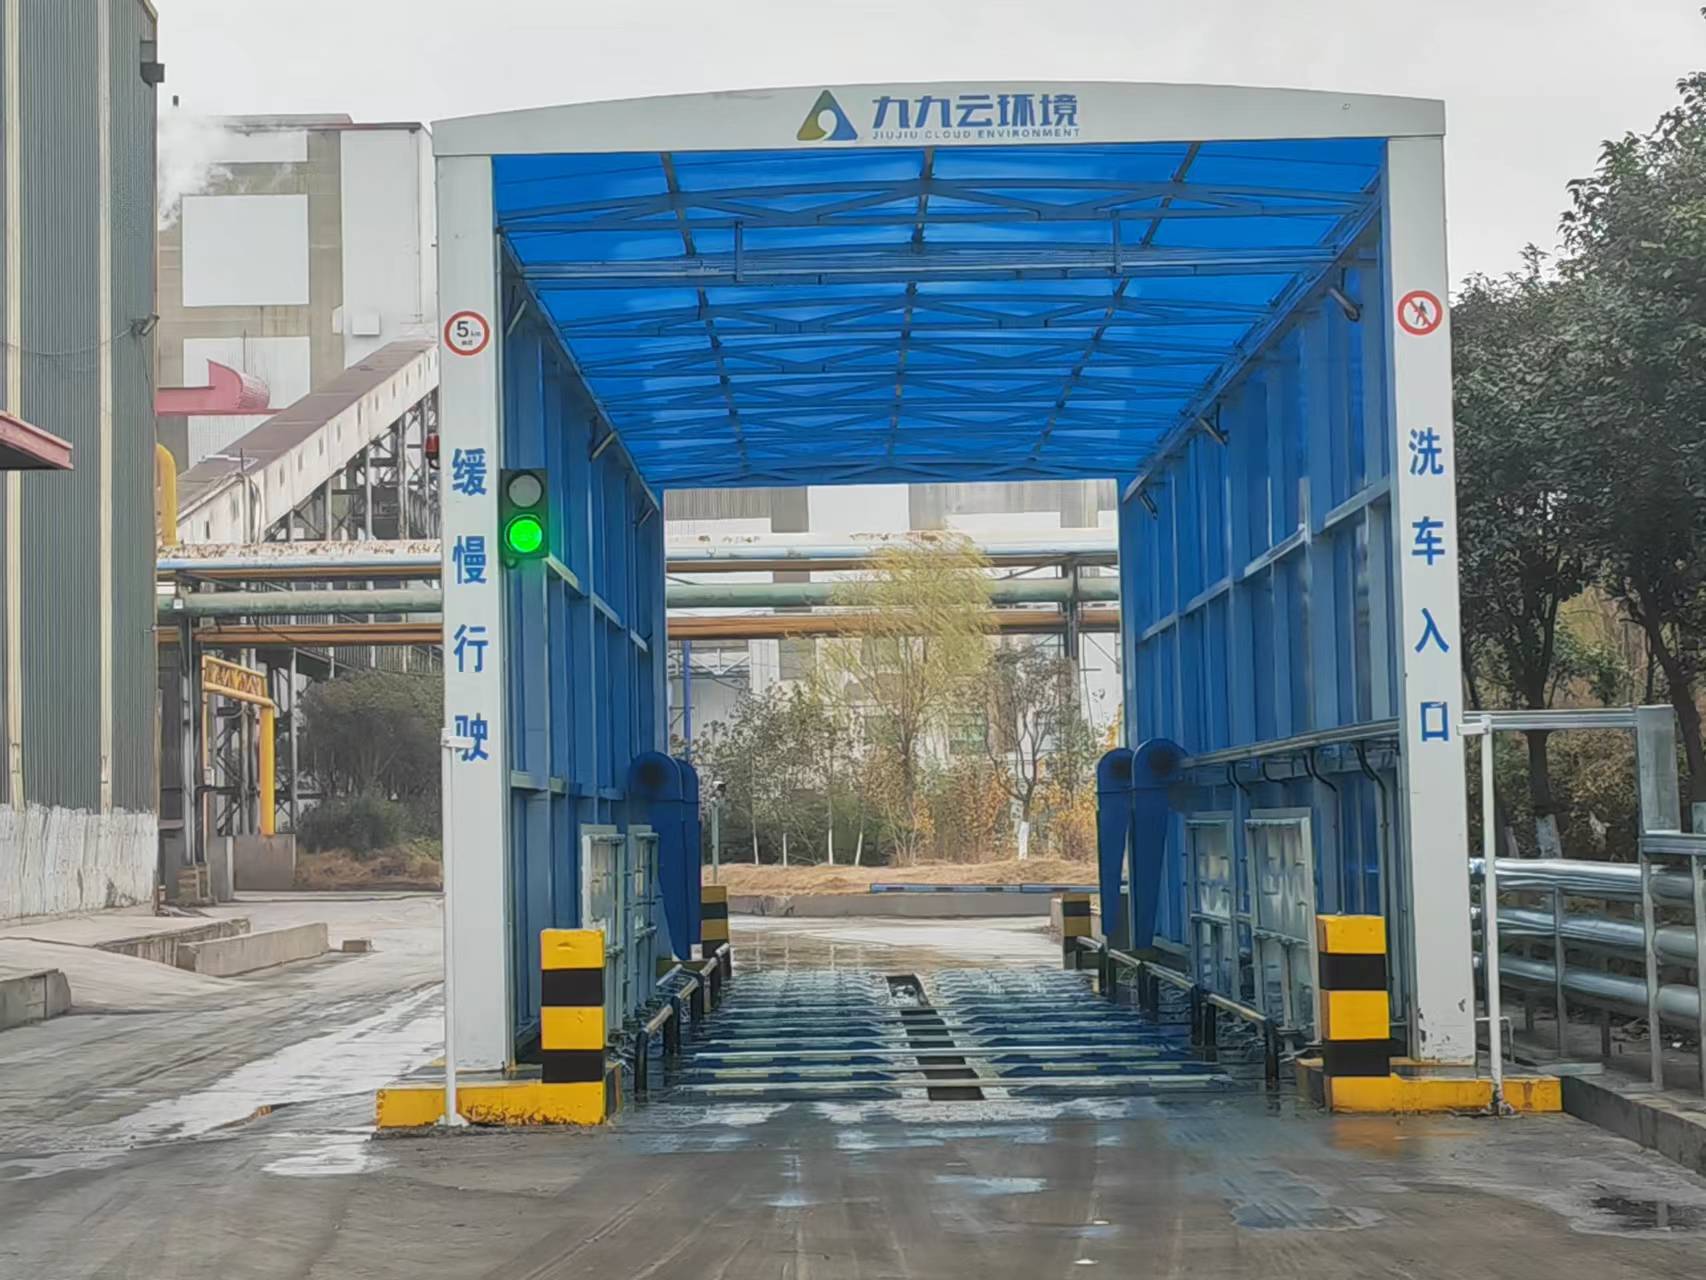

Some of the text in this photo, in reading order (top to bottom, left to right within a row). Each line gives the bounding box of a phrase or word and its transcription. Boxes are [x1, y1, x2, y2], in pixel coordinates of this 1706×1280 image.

[872, 94, 1078, 129] 九九云环境
[872, 127, 1080, 140] JIUJIU CLOUD ENVIRONMENT
[456, 320, 469, 338] 5
[1408, 427, 1450, 742] 洗车入口
[452, 447, 488, 762] 缓慢行驶
